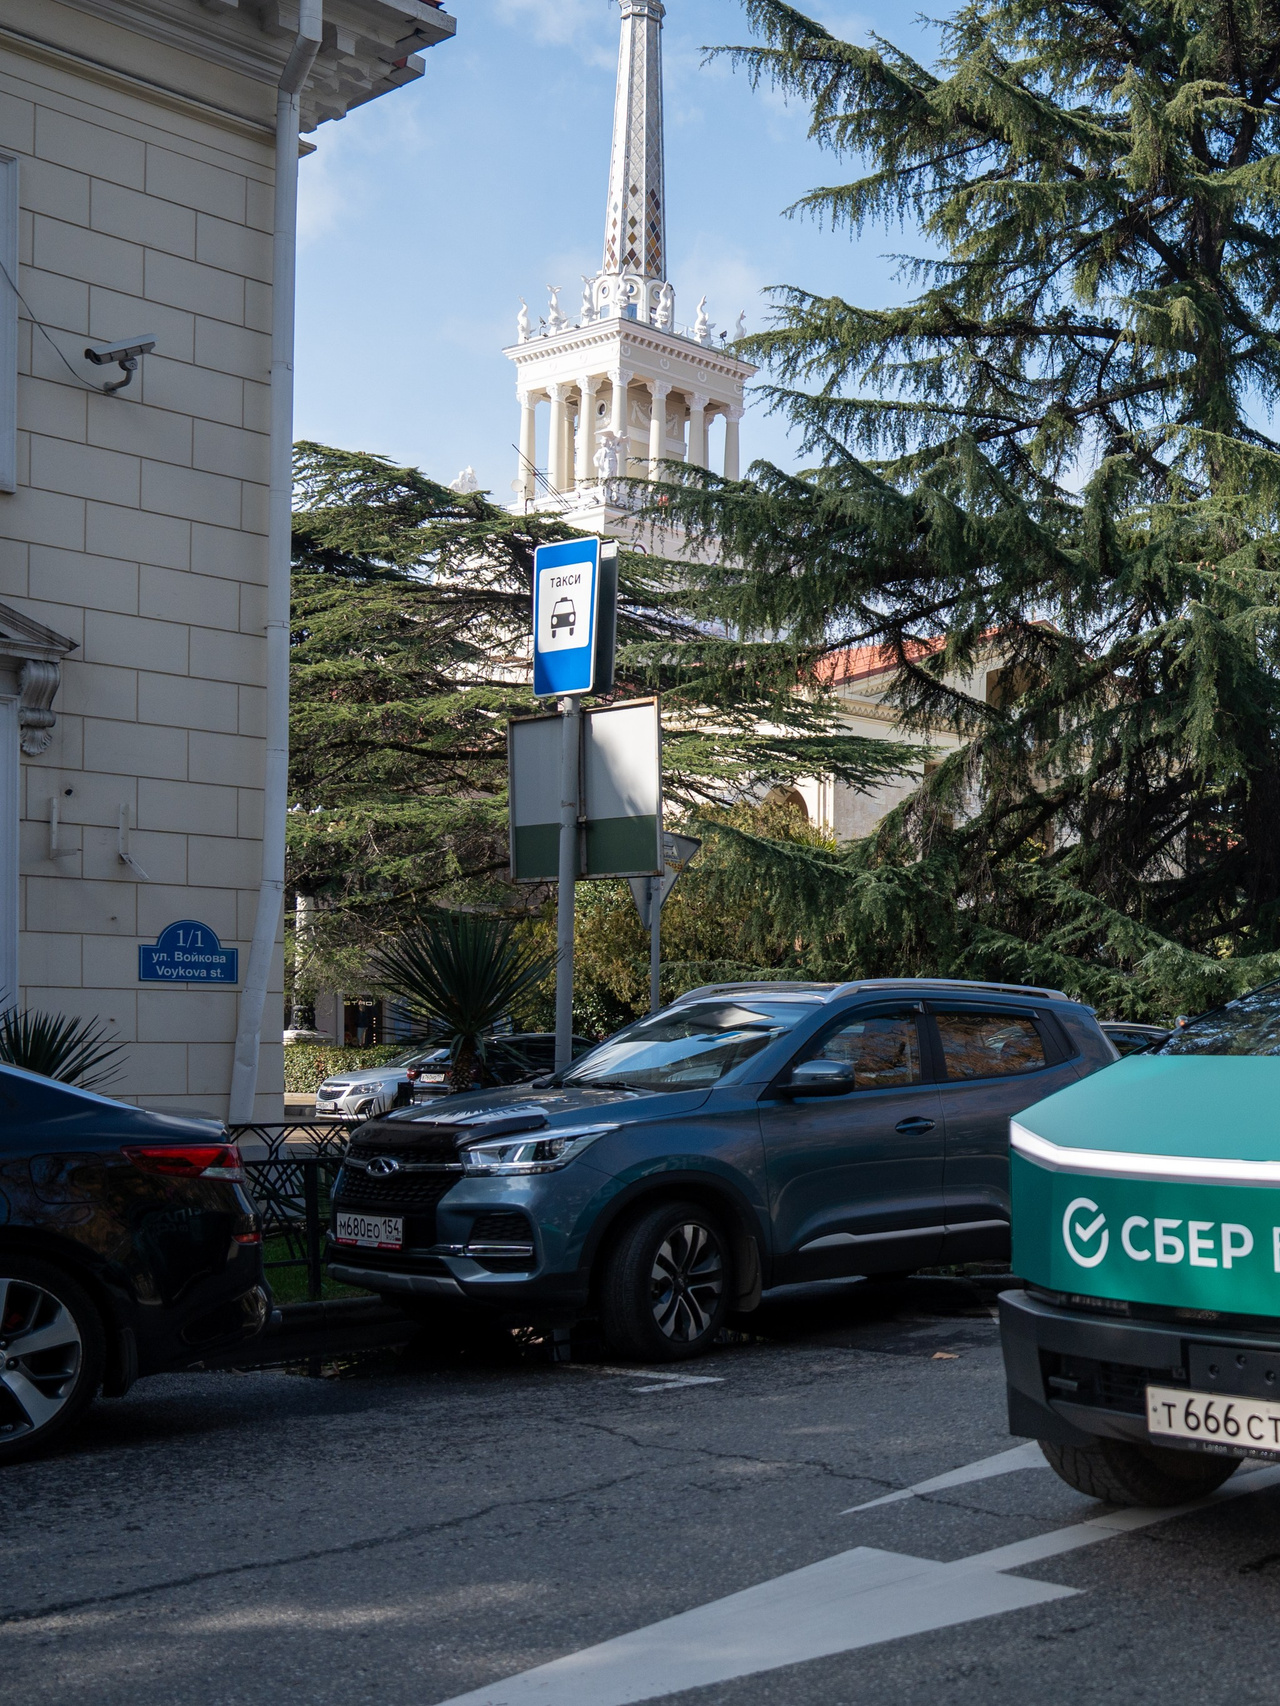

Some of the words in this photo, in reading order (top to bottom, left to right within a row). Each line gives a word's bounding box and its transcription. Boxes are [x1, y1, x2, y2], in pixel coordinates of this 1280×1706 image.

[550, 573, 581, 588] такси
[176, 929, 204, 948] 1/1
[152, 952, 170, 963] ул.
[174, 951, 226, 963] Войкова
[156, 965, 207, 978] Voykova
[210, 969, 224, 978] st.
[382, 1218, 400, 1235] 154
[1121, 1215, 1254, 1269] СБЕР
